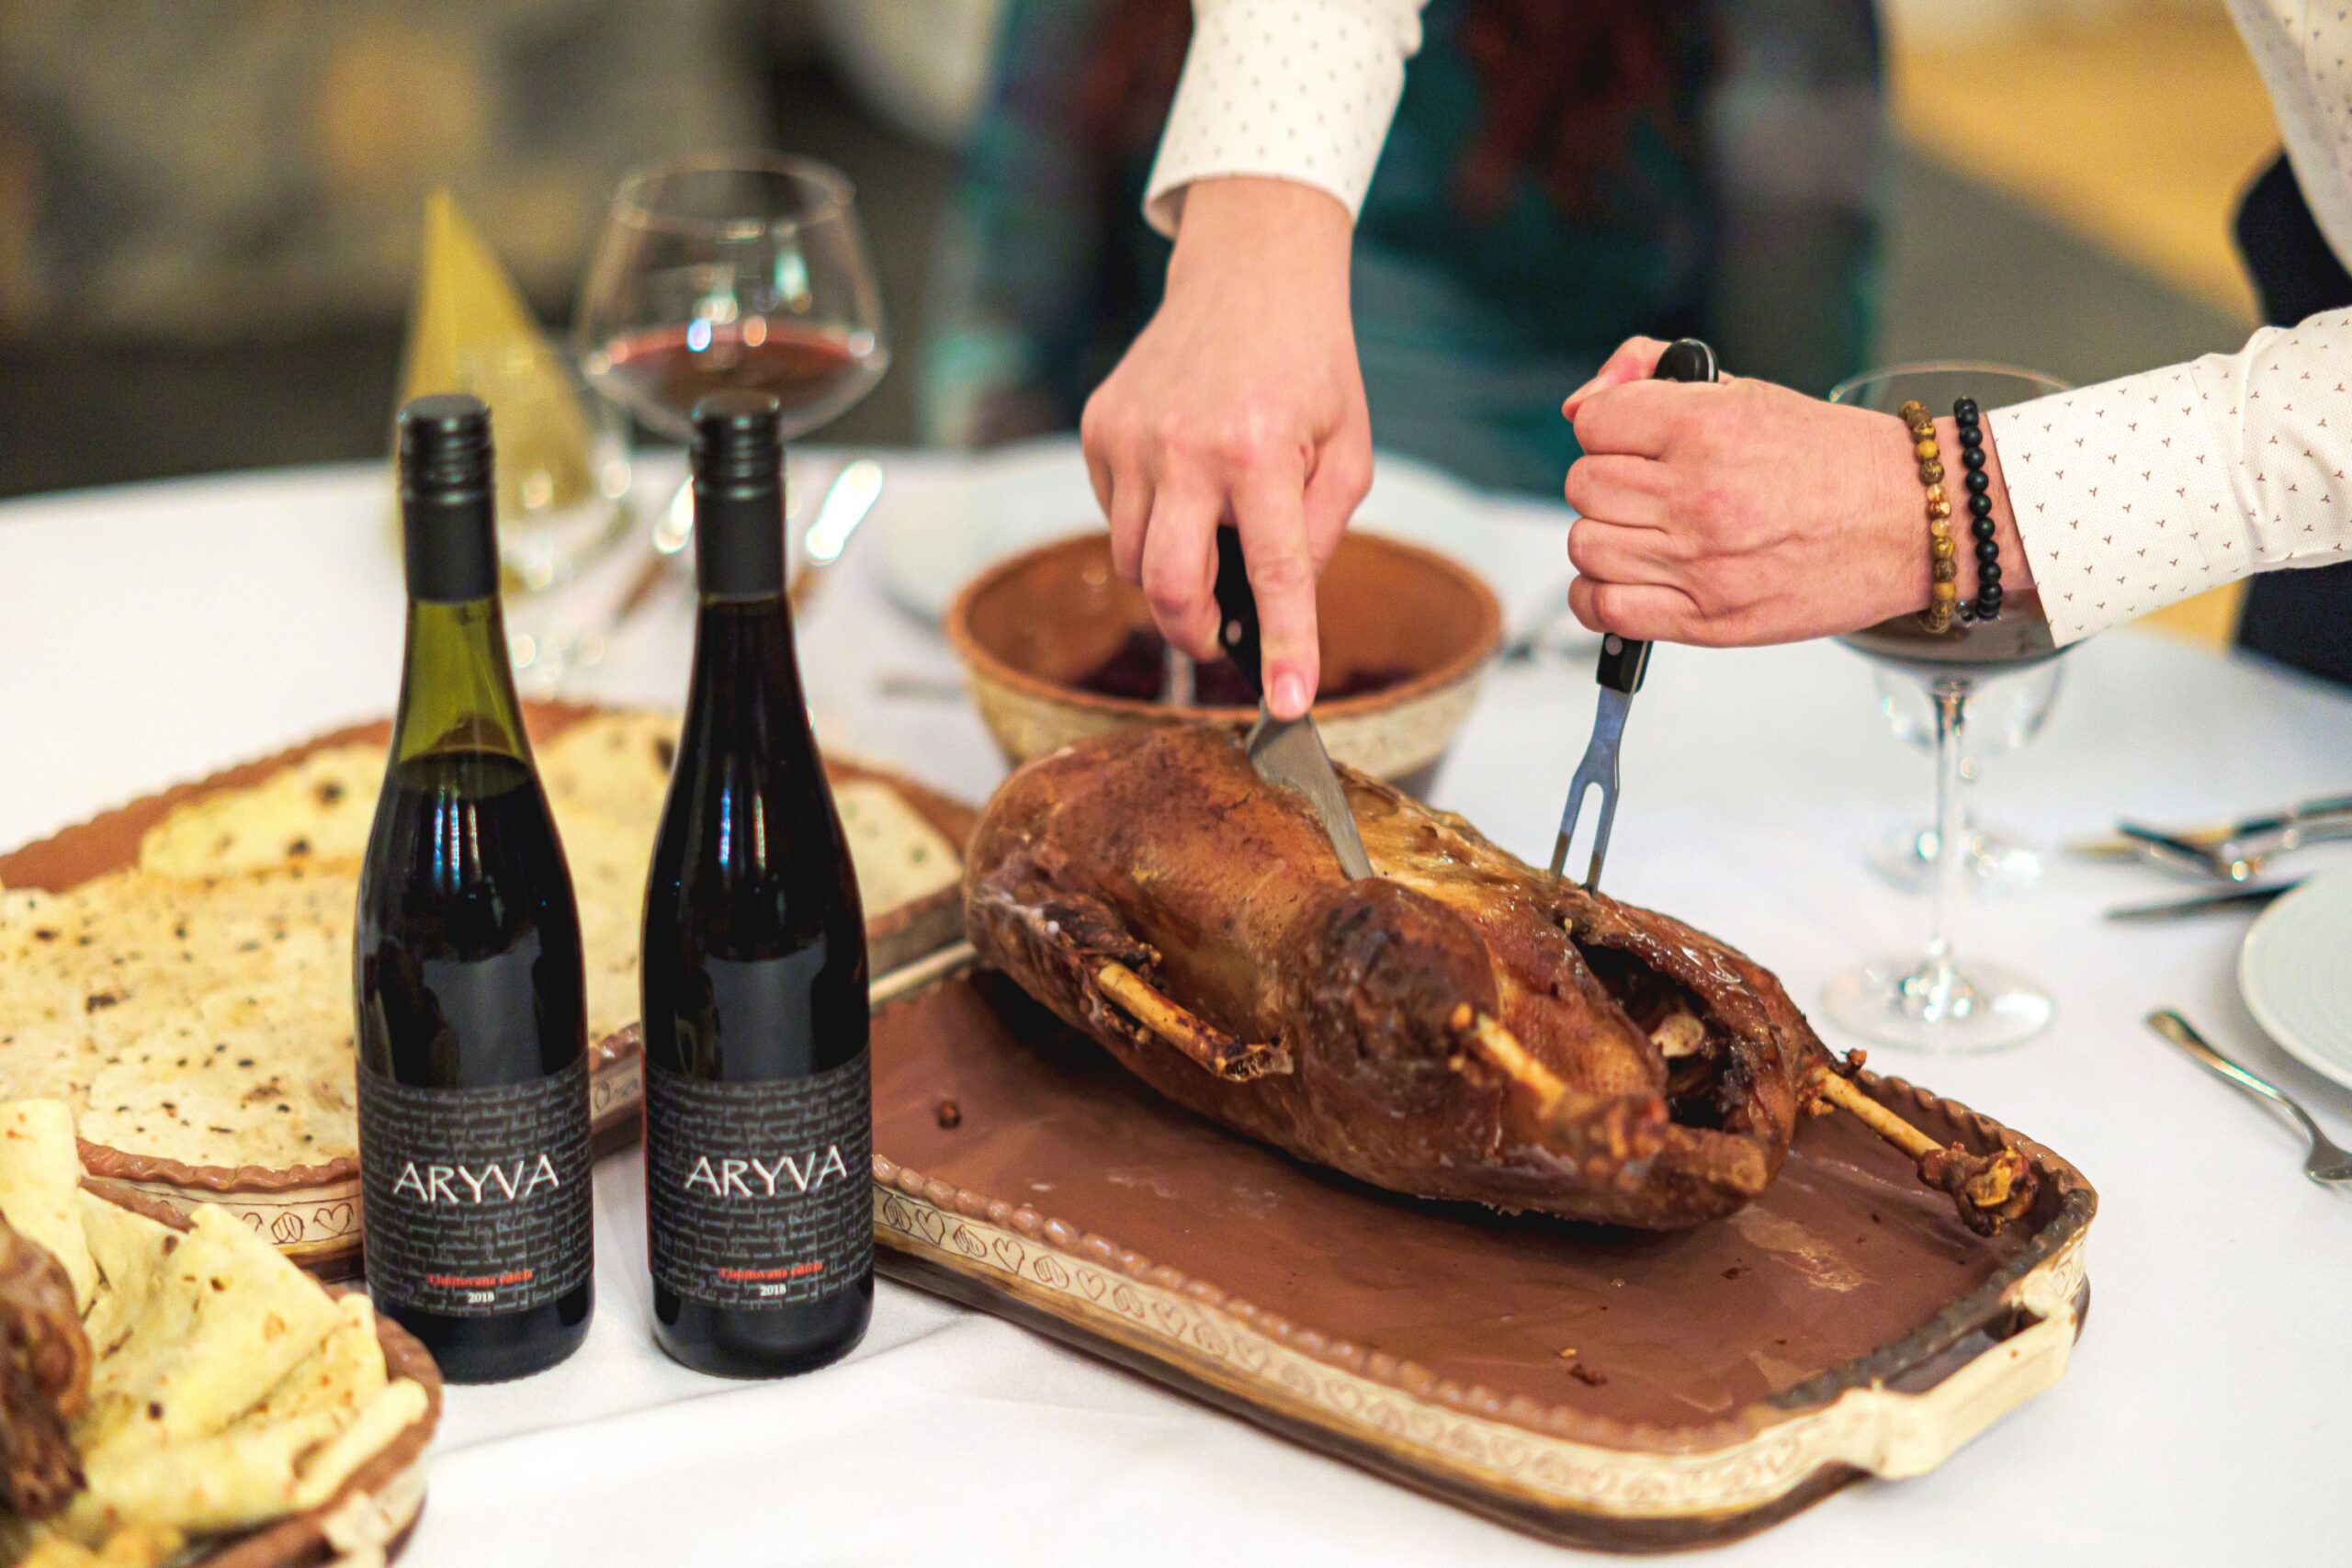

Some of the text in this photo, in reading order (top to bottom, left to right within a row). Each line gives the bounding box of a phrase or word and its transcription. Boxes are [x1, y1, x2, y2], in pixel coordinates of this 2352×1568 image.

[393, 1155, 560, 1204] ARYVA
[685, 1145, 847, 1198] ARYVA
[468, 1292, 495, 1303] 2018
[759, 1284, 787, 1296] 2018
